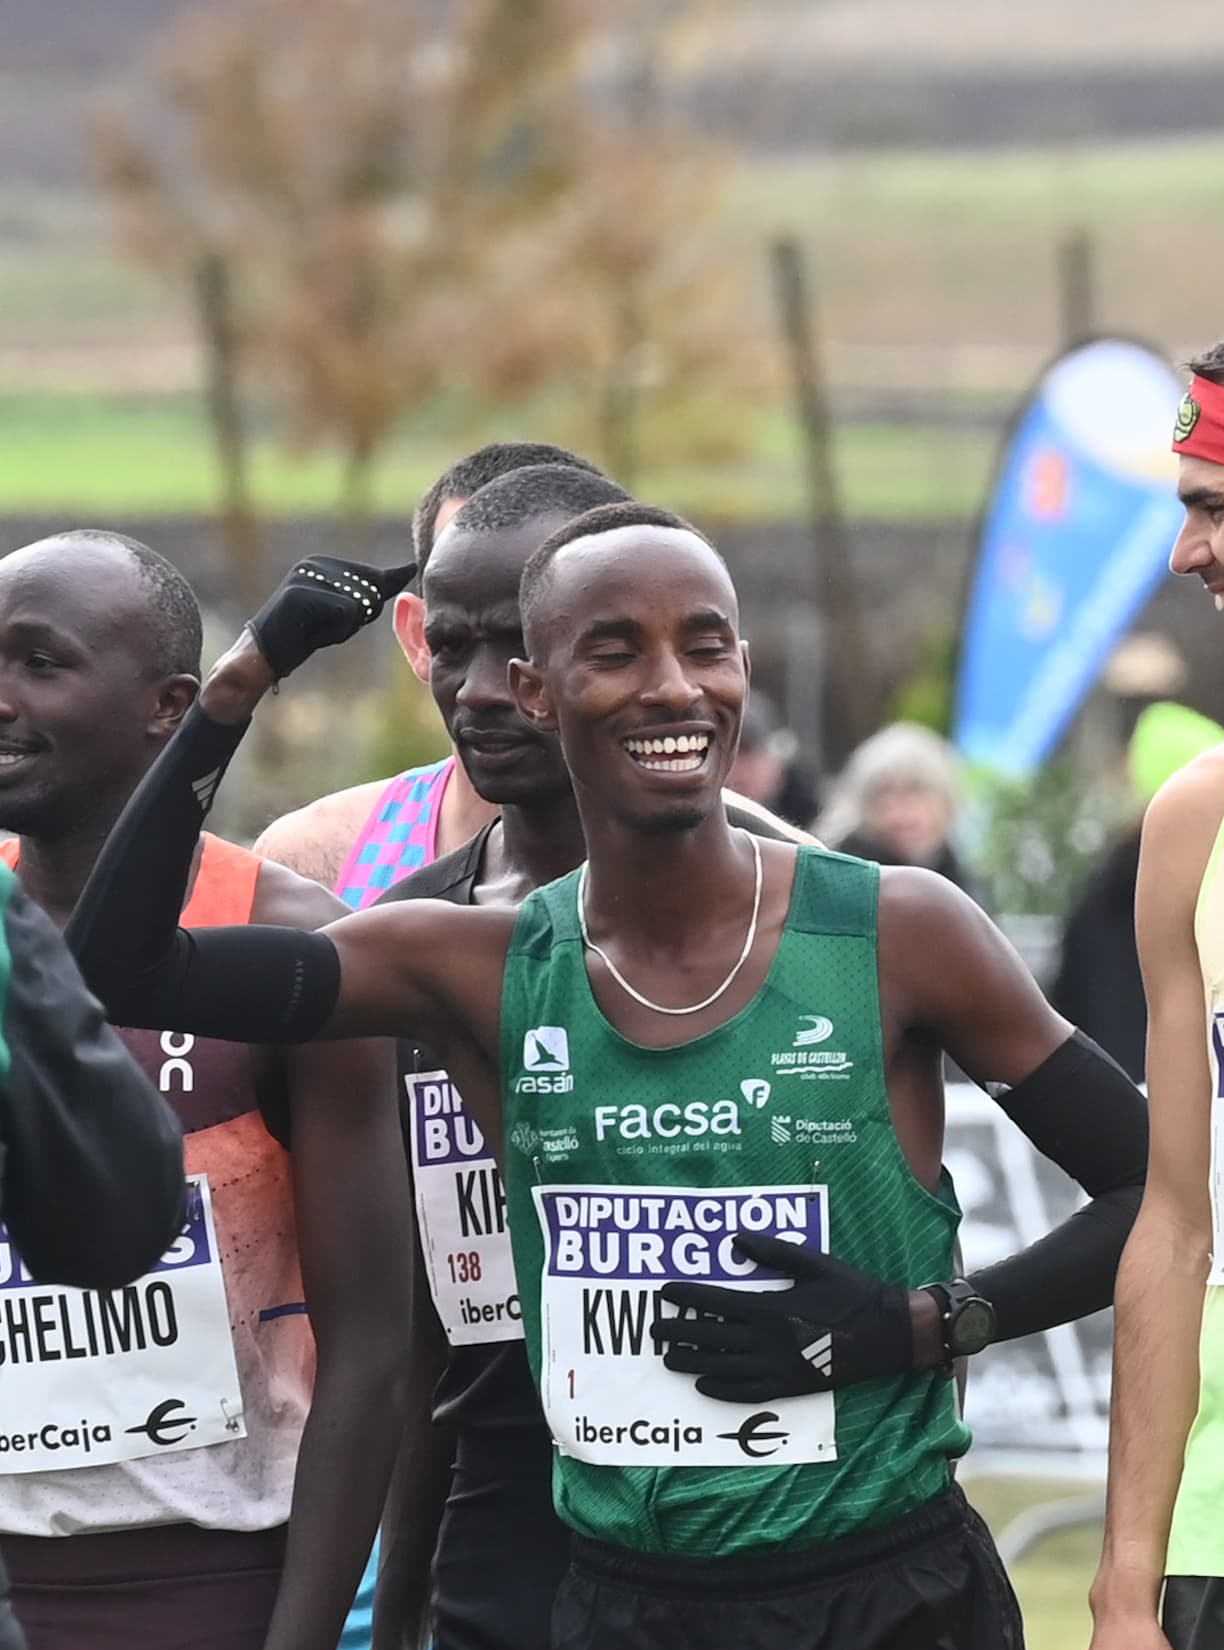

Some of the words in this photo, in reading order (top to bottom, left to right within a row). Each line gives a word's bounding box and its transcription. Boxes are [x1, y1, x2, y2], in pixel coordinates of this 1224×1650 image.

[797, 1052, 808, 1065] DE
[796, 1119, 852, 1131] Diputació
[796, 1132, 811, 1143] de
[812, 1132, 857, 1144] Castelló
[616, 1145, 644, 1155] ciclo
[648, 1142, 690, 1155] integral
[693, 1141, 710, 1151] del
[556, 1194, 807, 1232] DIPUTACIÓN
[448, 1251, 482, 1284] 138
[0, 1281, 178, 1367] HELIMO
[460, 1295, 523, 1325] iberC
[567, 1369, 575, 1399] 1
[575, 1416, 702, 1451] iberCaja
